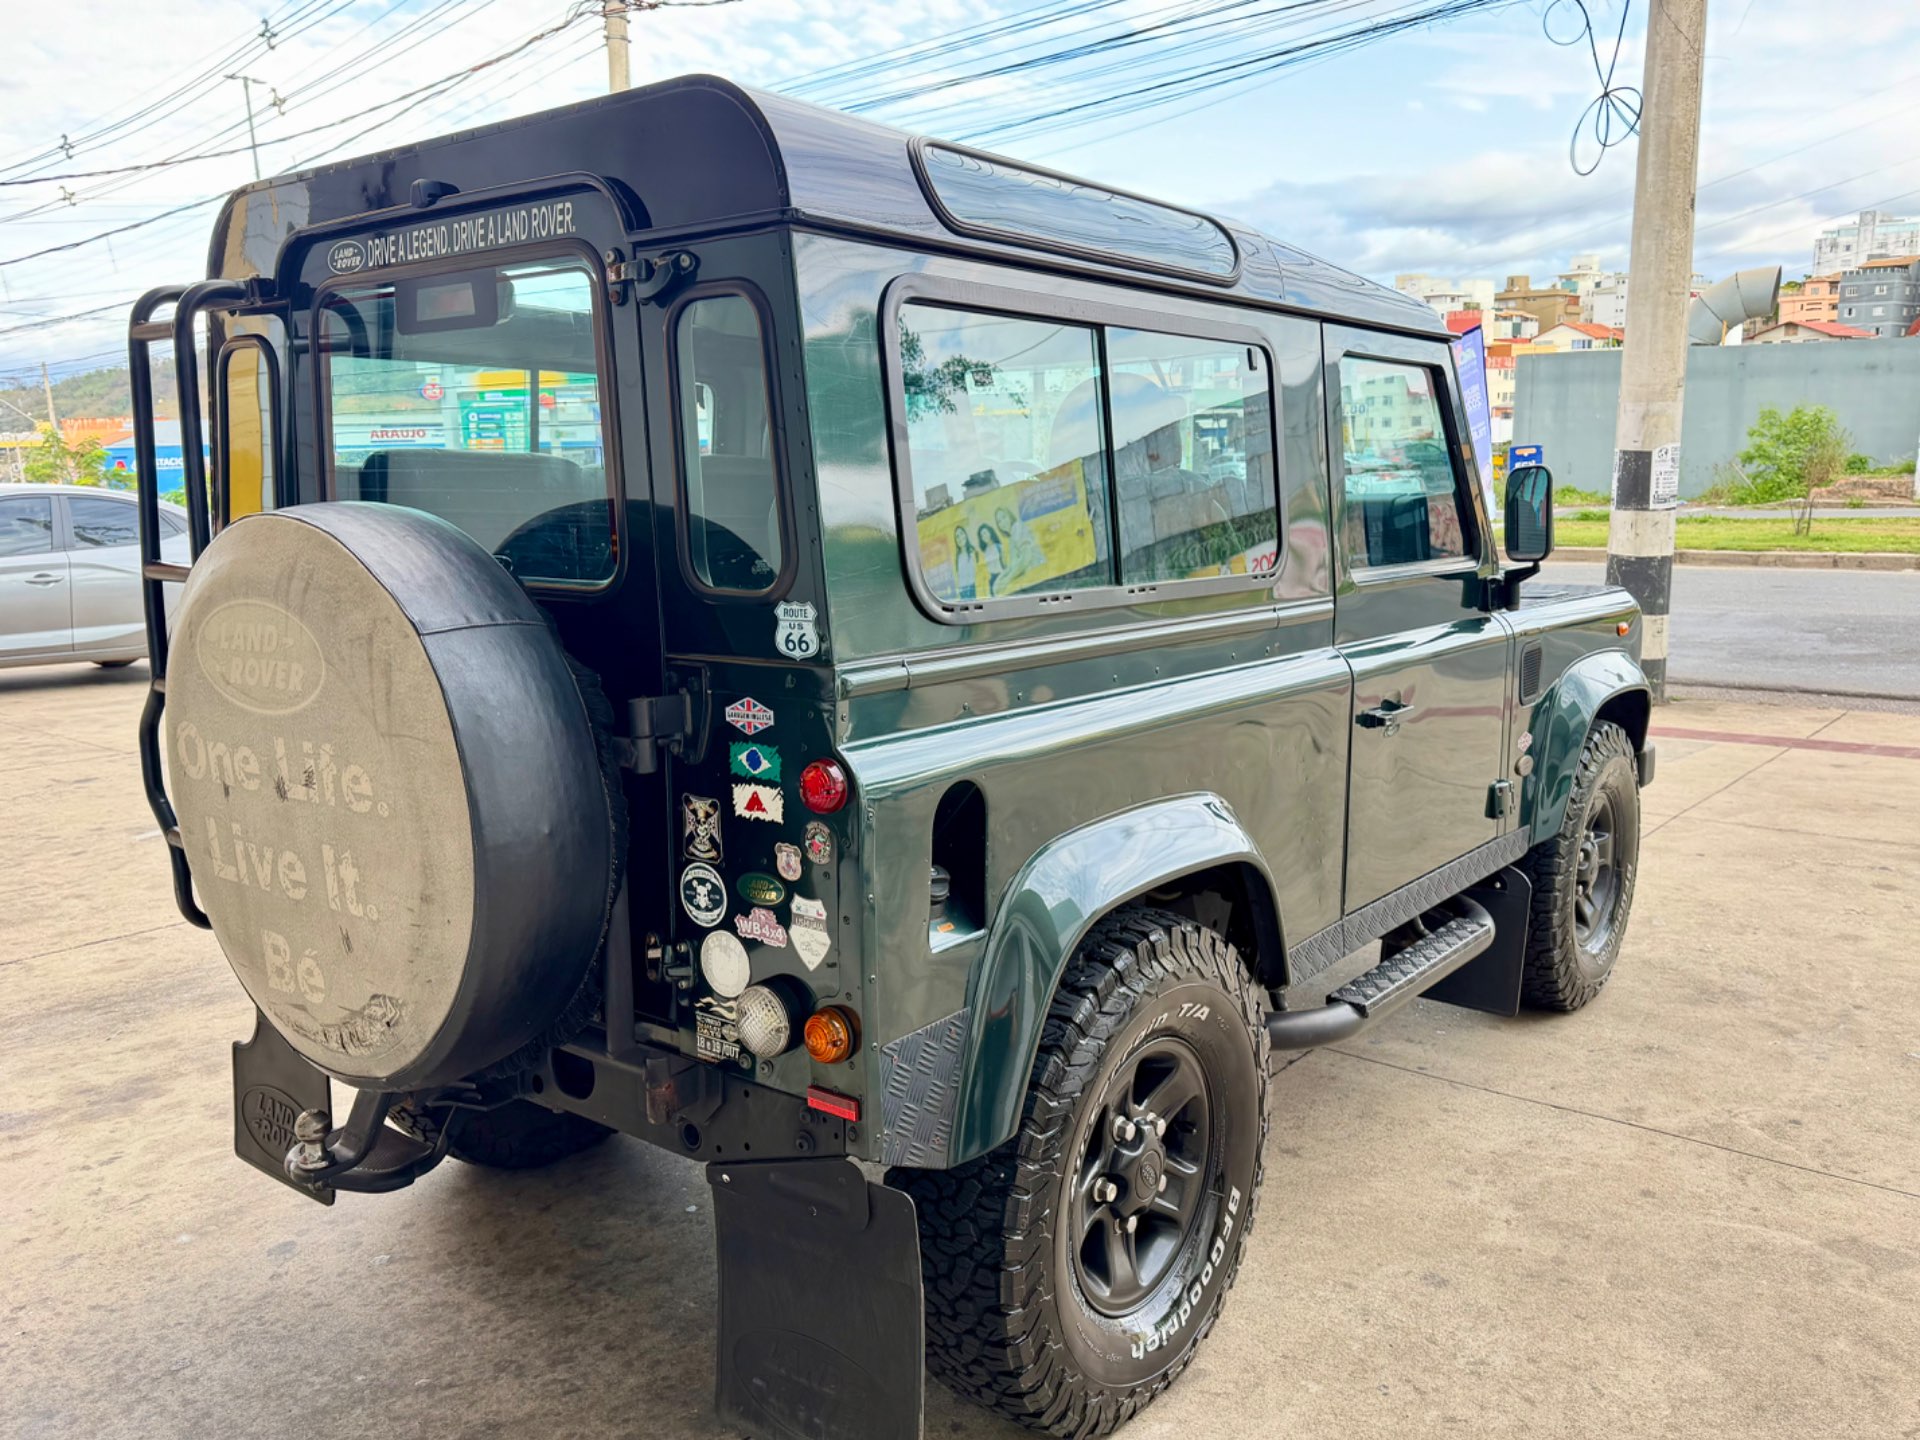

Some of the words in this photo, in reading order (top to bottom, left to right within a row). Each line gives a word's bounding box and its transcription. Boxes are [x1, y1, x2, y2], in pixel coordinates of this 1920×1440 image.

[367, 235, 396, 267] DRIVE
[398, 233, 406, 262] A
[406, 225, 451, 260] LEGEND.
[453, 217, 485, 252] DRIVE
[487, 215, 496, 246] A
[498, 210, 528, 244] LAND
[531, 201, 576, 239] ROVER.
[334, 247, 355, 260] LAND
[336, 256, 361, 269] ROVER
[370, 429, 426, 440] ARAUJO
[783, 607, 808, 619] ROUTE
[788, 622, 804, 630] US
[219, 622, 279, 655] LAND
[784, 632, 810, 653] 66
[229, 655, 304, 693] ROVER
[176, 721, 262, 791] One
[273, 735, 389, 818] Life.
[205, 815, 308, 901] Live
[322, 843, 379, 921] It.
[1178, 1002, 1211, 1021] T/A
[257, 1091, 296, 1126] LAND
[260, 1118, 297, 1152] ROV
